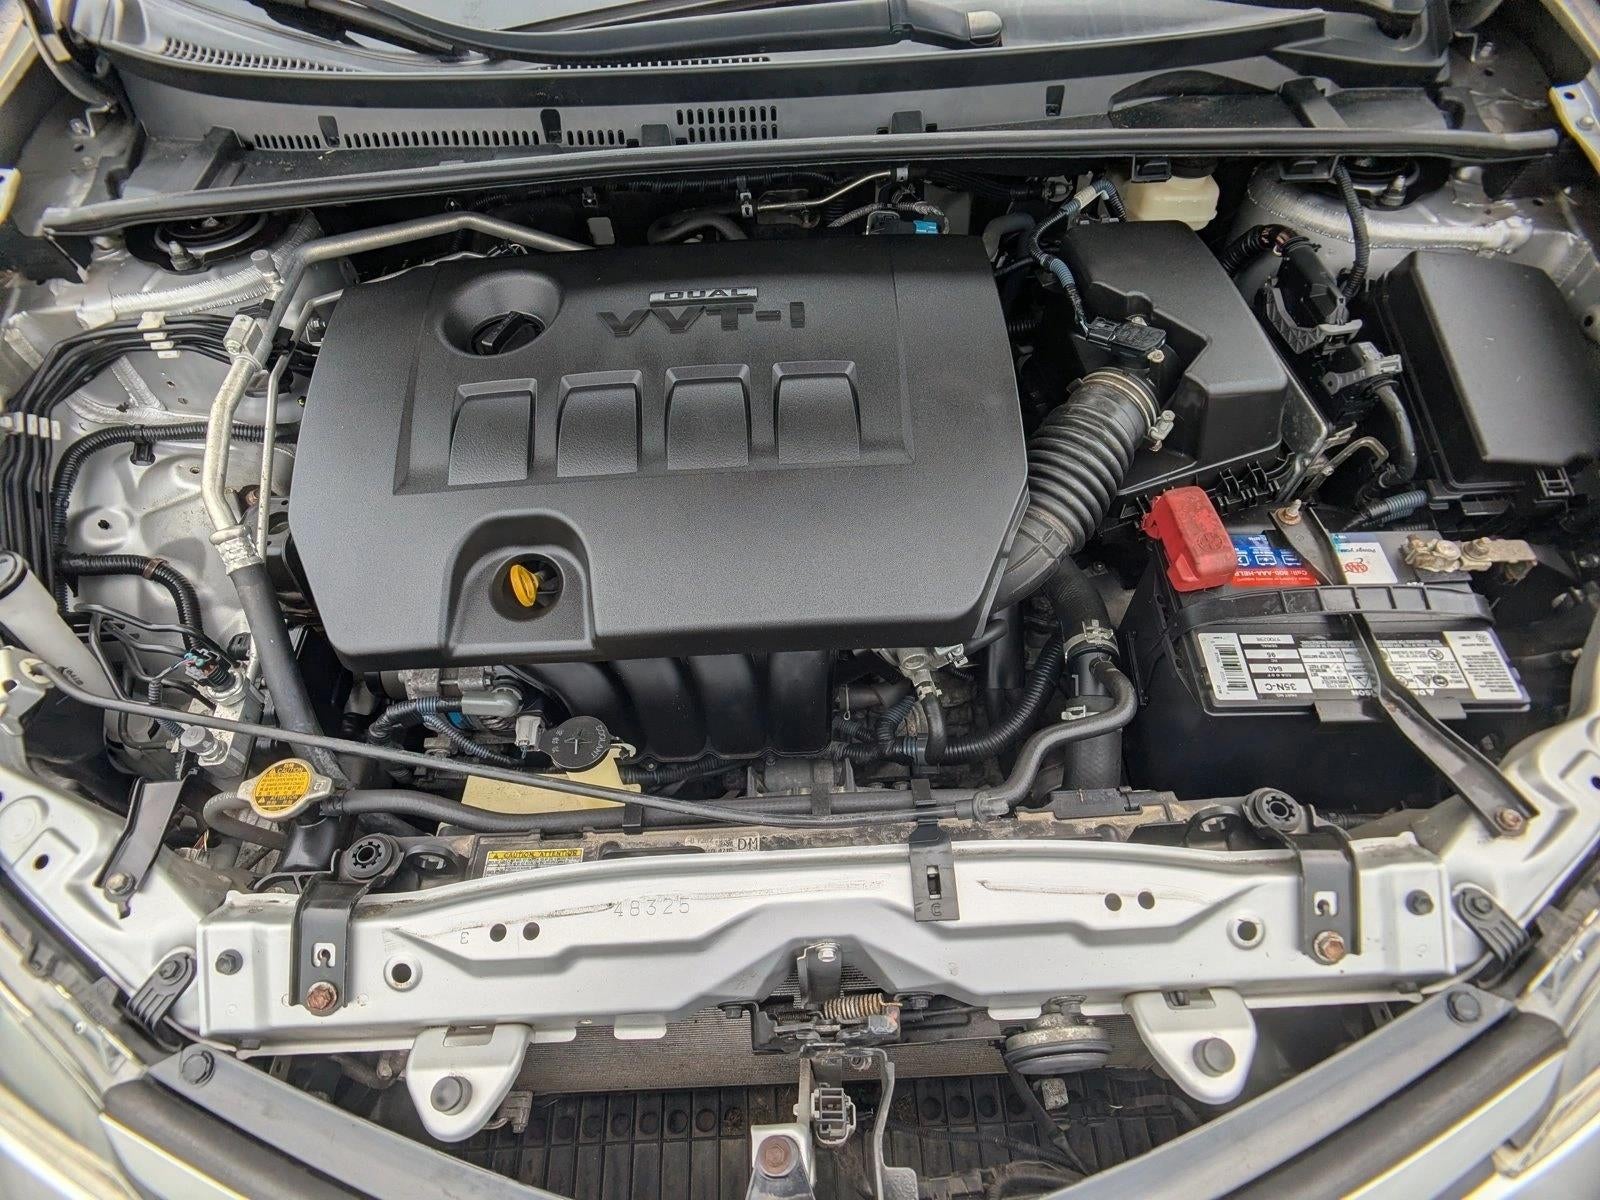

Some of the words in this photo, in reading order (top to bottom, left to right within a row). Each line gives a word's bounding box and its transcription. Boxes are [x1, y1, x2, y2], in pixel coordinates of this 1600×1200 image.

[664, 288, 748, 300] DUAL
[1265, 683, 1297, 691] 35N-C
[590, 724, 607, 759] COOLANT
[737, 837, 759, 851] DM
[503, 850, 534, 859] CAUTION
[613, 896, 690, 917] 48325
